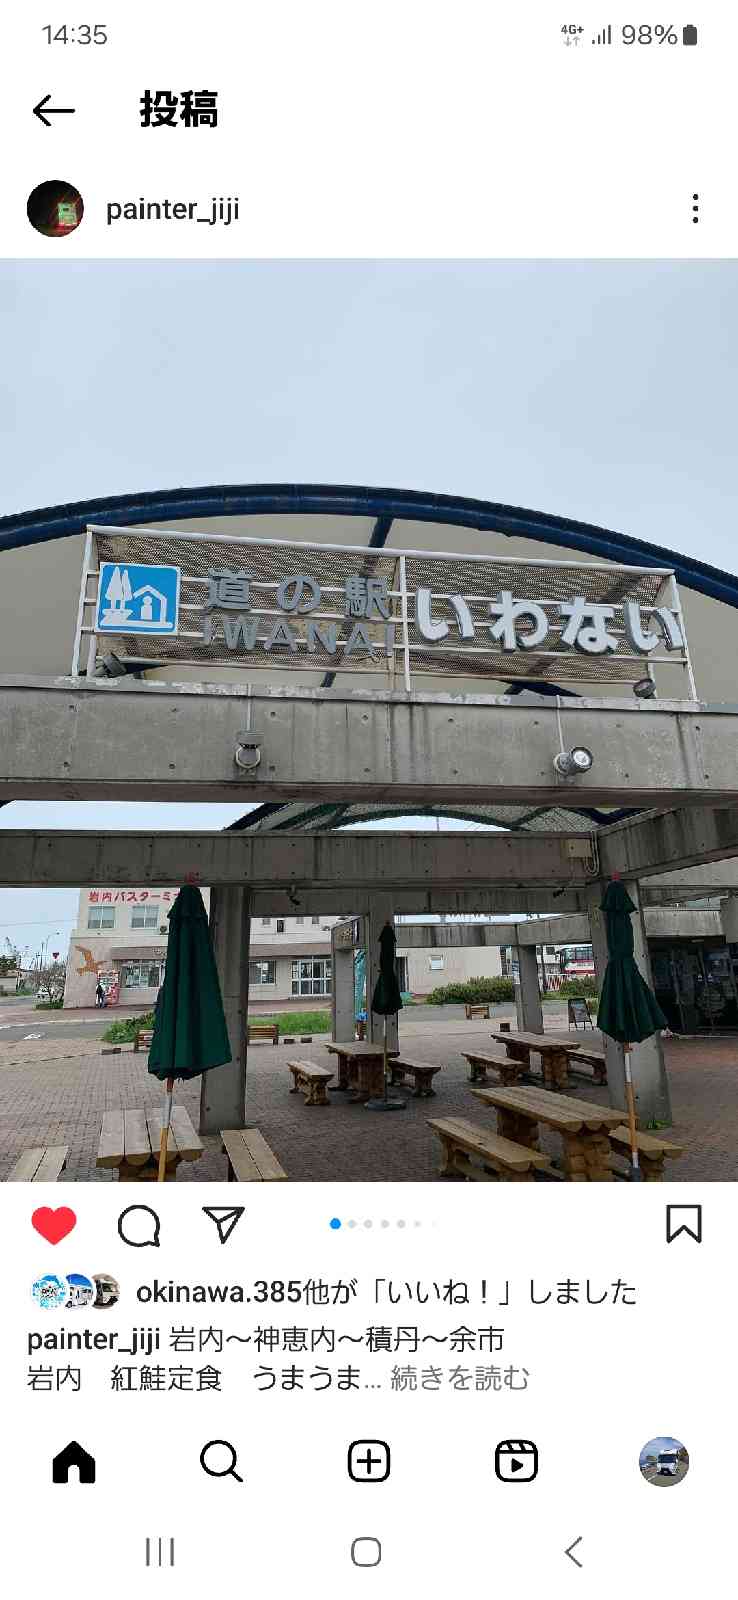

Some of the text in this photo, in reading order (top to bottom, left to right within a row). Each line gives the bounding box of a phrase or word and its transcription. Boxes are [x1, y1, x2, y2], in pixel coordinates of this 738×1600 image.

[202, 612, 396, 657] IWANAI
[205, 567, 683, 656] 道の駅 いわない
